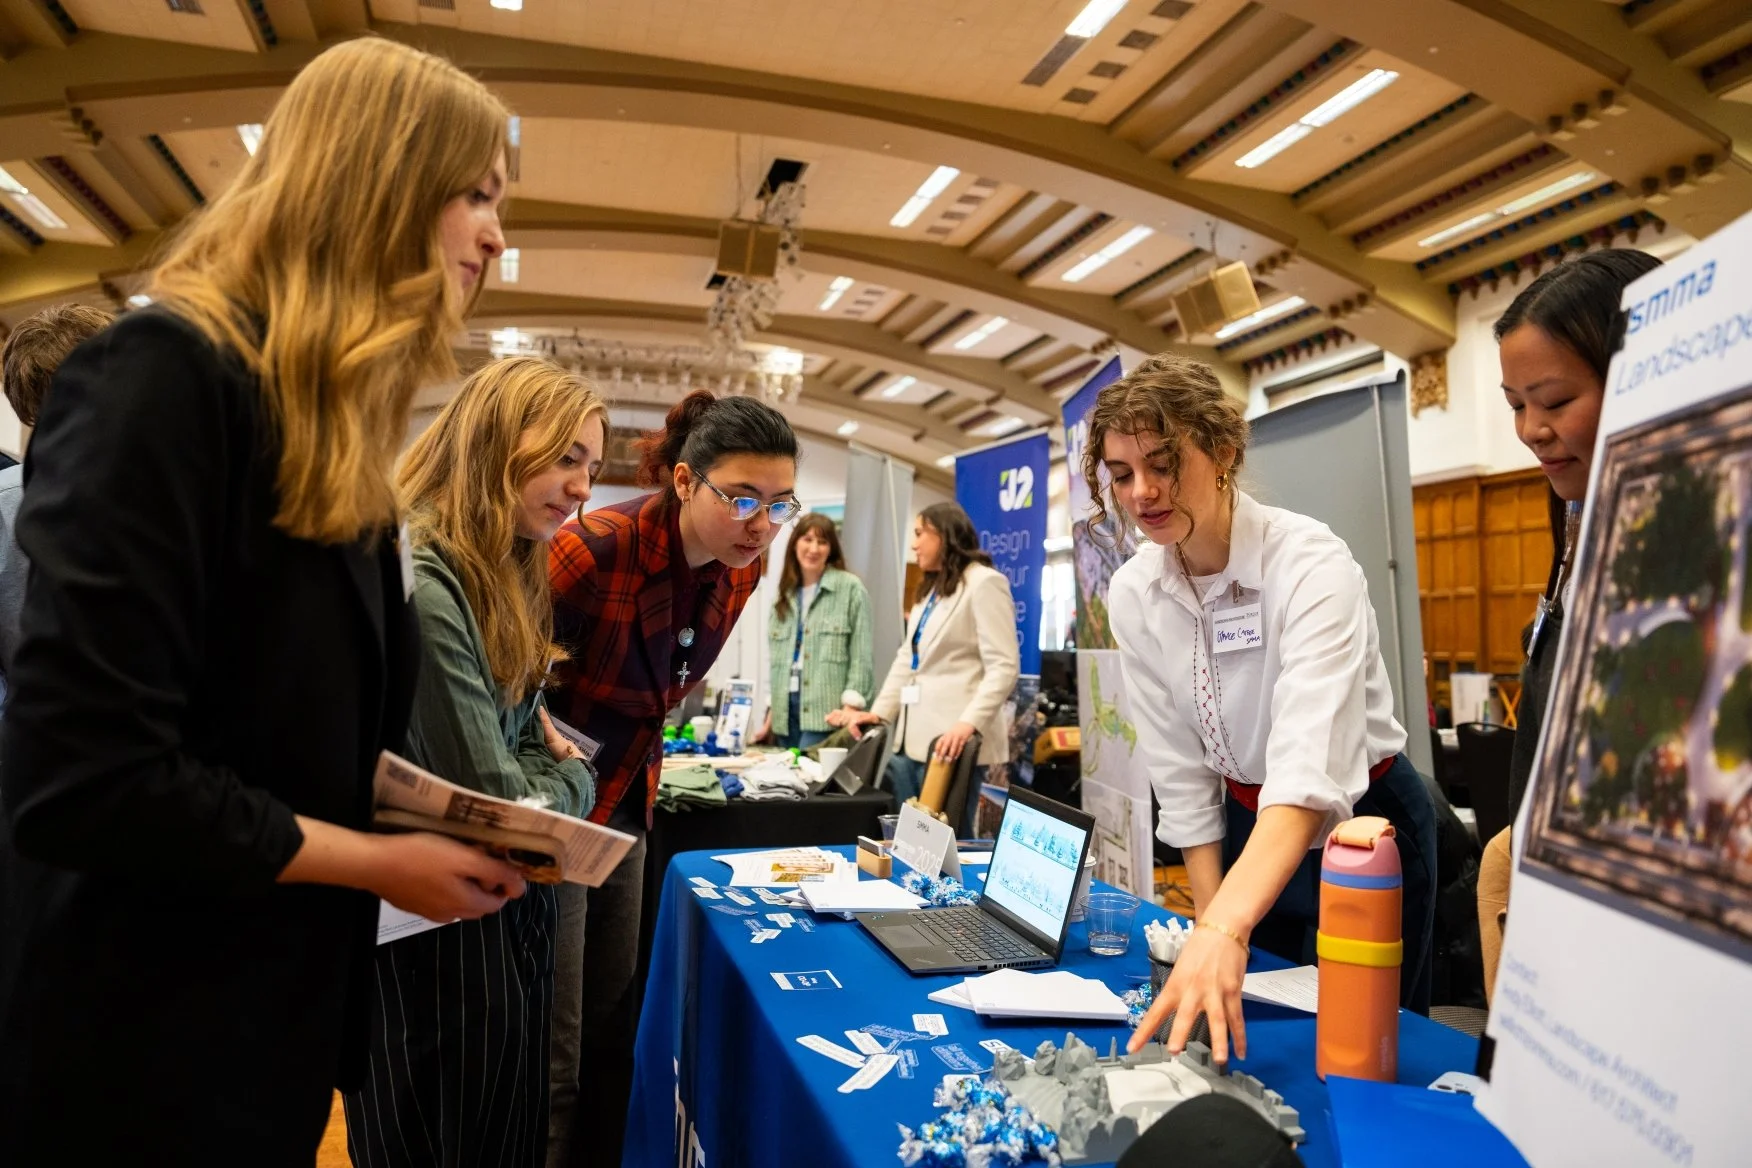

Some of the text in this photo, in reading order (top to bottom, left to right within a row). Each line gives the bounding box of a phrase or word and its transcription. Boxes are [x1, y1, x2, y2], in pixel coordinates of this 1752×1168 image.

[1628, 259, 1718, 334] smma
[999, 465, 1034, 512] J2
[980, 529, 1030, 561] Design
